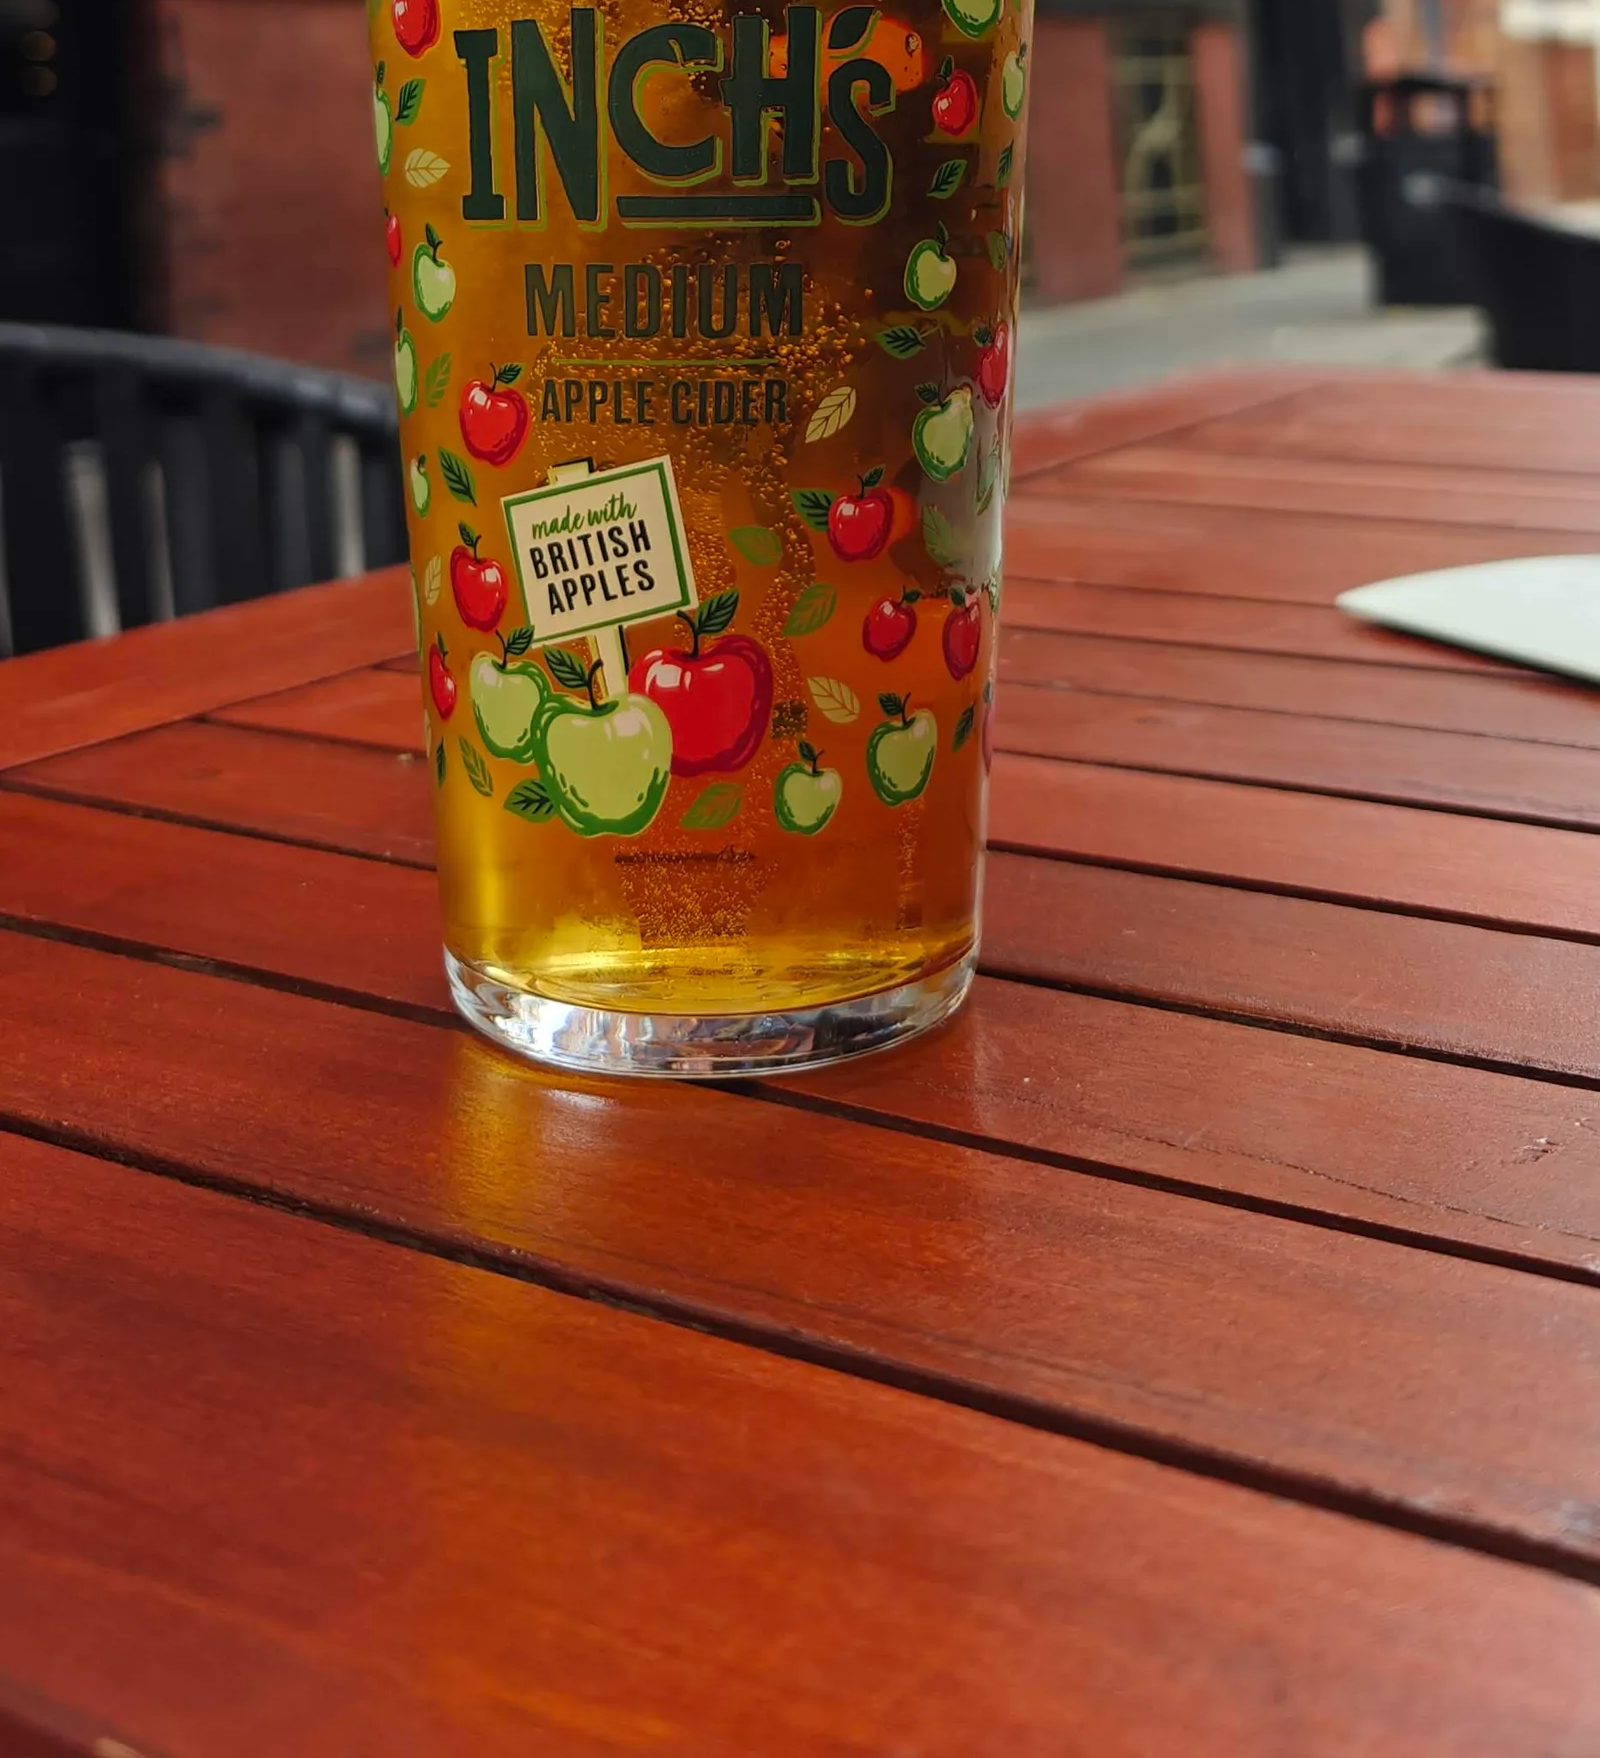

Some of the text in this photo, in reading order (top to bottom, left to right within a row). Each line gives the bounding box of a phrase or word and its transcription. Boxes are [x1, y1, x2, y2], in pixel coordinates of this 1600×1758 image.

[524, 263, 803, 339] MEDIUM
[541, 378, 790, 425] APPLE CIDER
[531, 491, 637, 540] made with
[529, 519, 651, 579] BRITISH
[547, 559, 655, 615] APPLES
